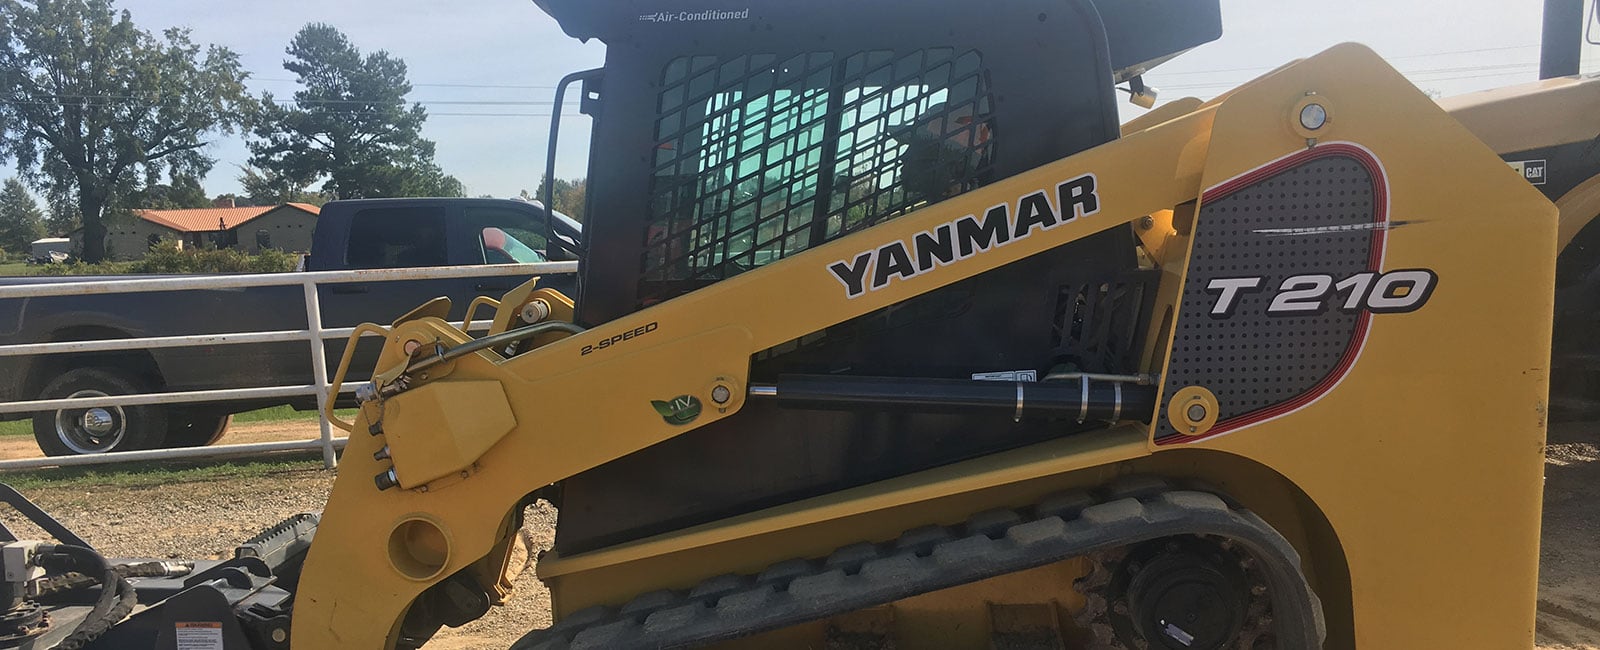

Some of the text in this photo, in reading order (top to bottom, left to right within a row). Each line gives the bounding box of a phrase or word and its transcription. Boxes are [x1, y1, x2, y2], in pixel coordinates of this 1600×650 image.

[656, 8, 749, 22] Air-Conditioned
[1526, 167, 1544, 178] CAT
[826, 172, 1100, 299] YANMAR
[1206, 268, 1437, 318] T 210
[581, 321, 658, 356] 2-SPEED
